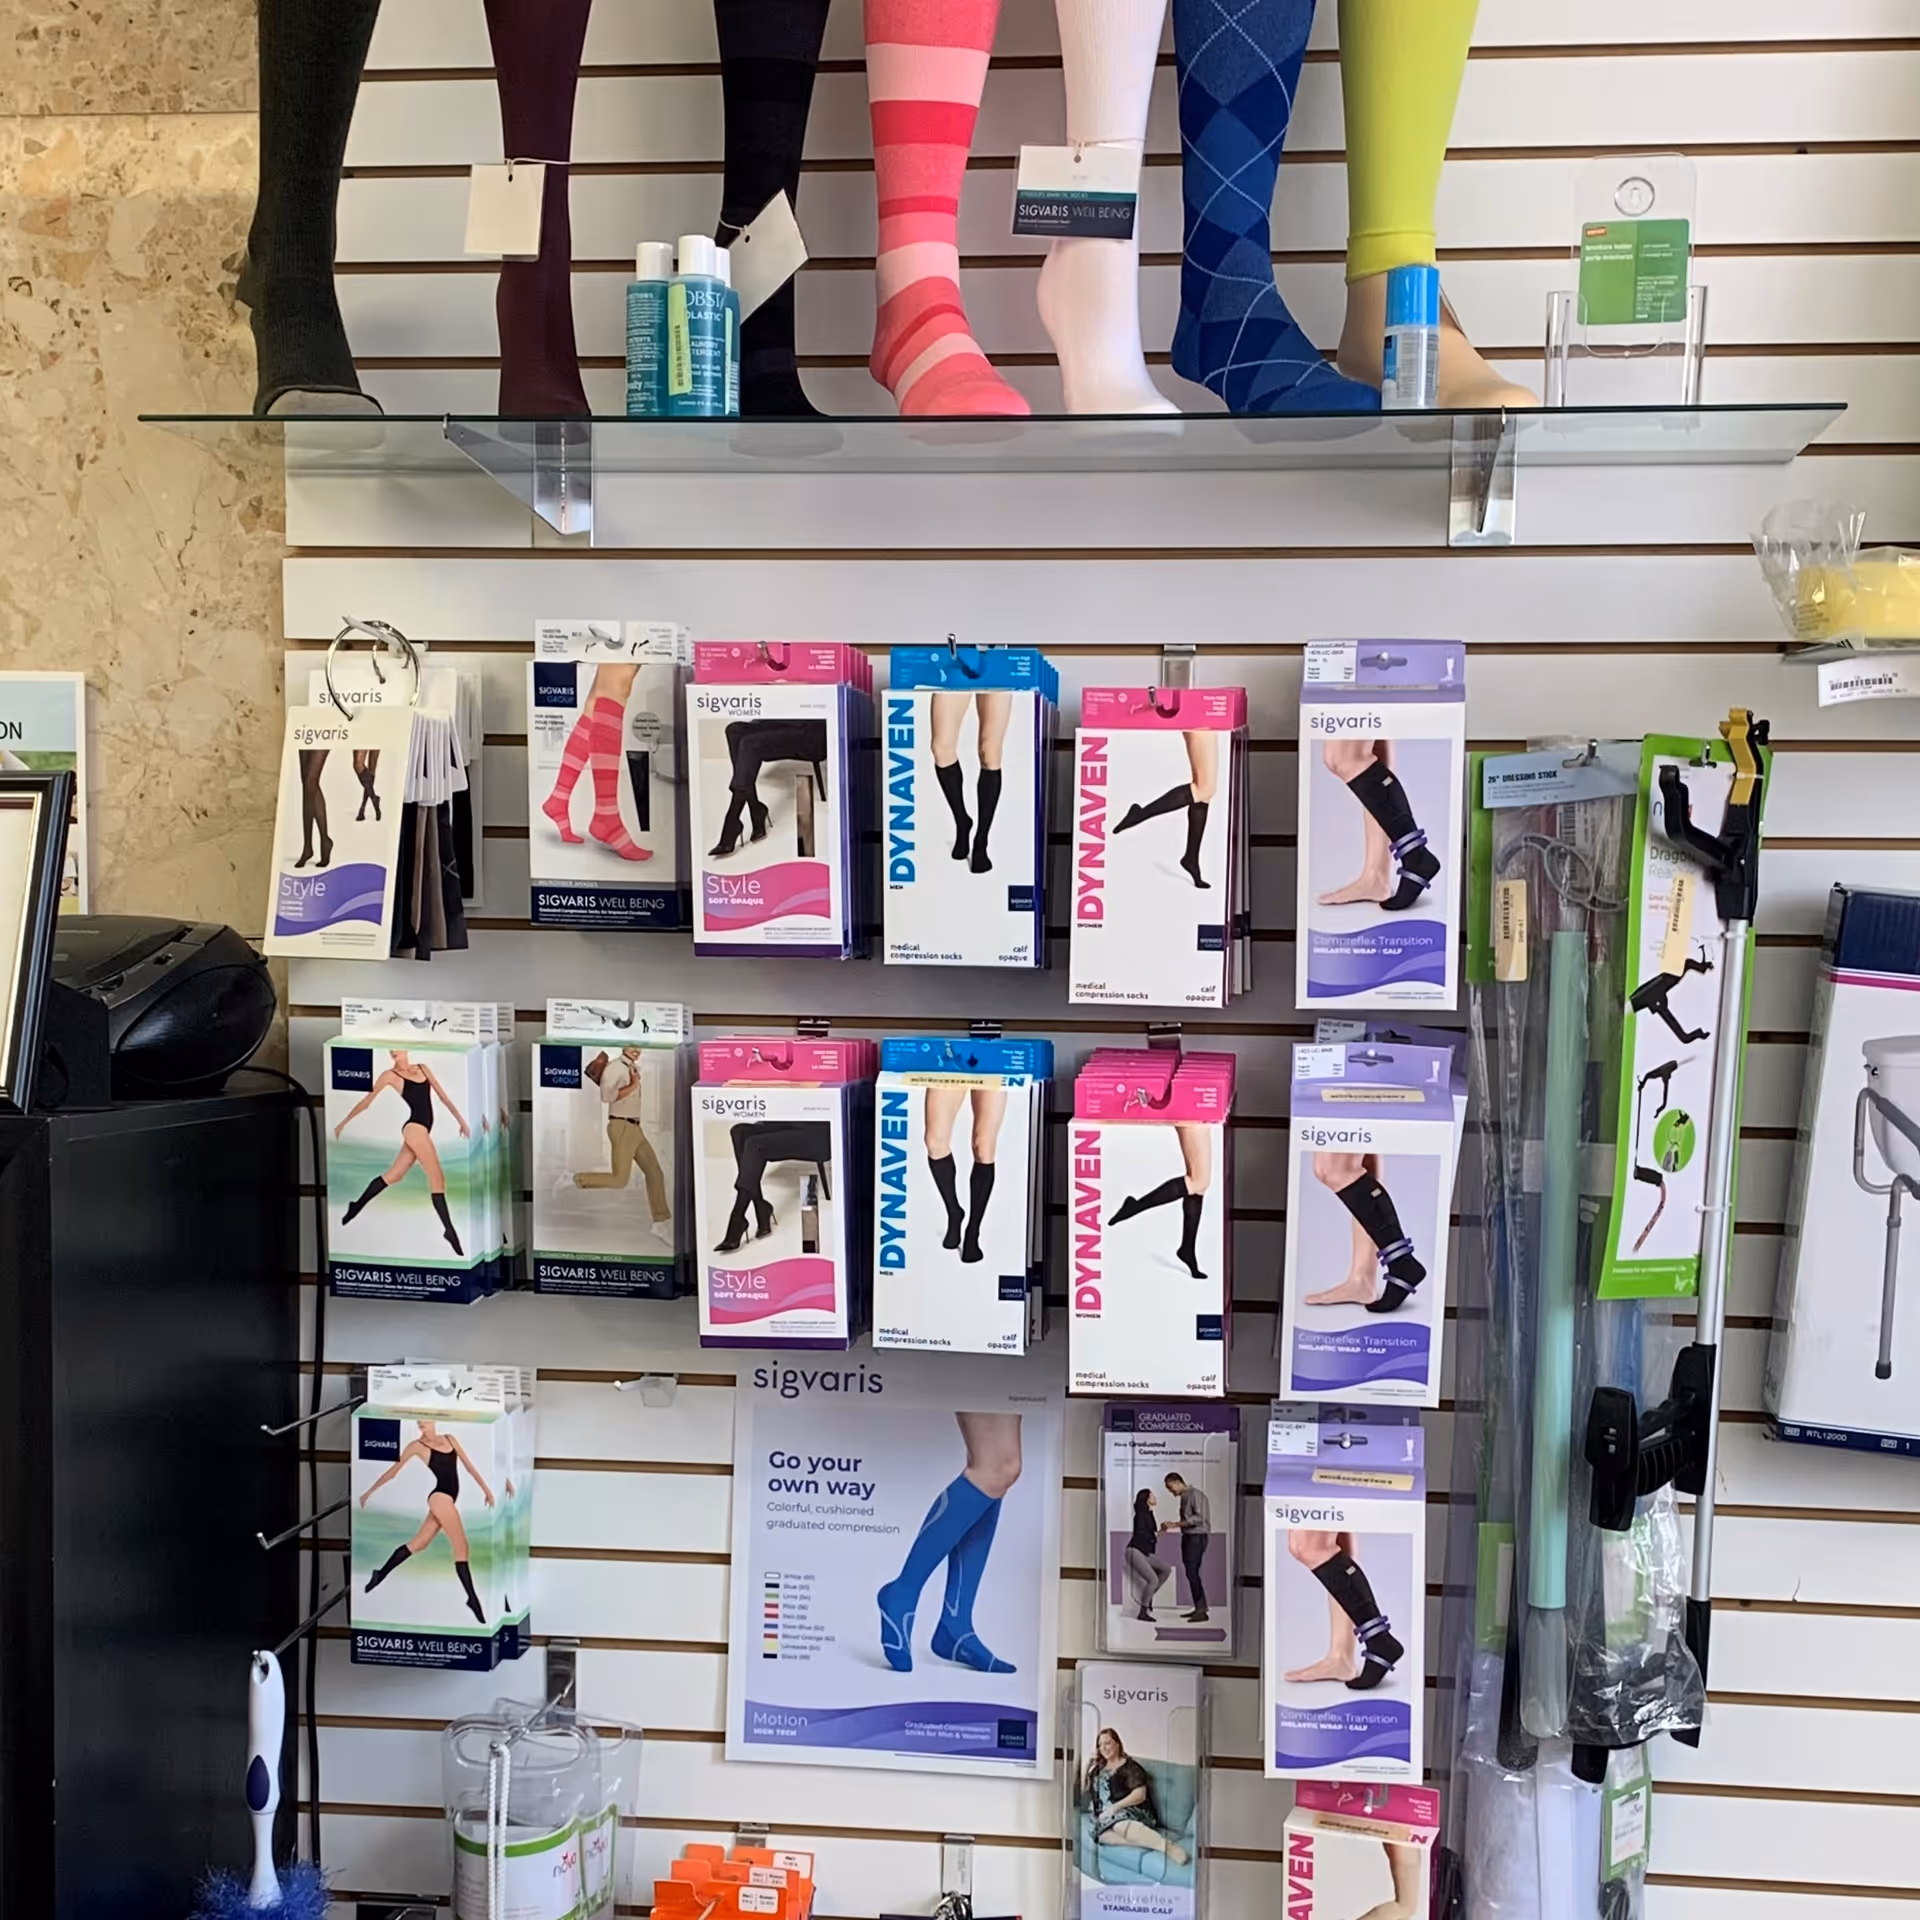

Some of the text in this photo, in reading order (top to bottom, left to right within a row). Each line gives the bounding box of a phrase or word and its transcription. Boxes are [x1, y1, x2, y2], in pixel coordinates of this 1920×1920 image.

[1019, 204, 1069, 217] SIGVARIS
[1098, 207, 1131, 219] BEING
[685, 290, 722, 308] OBST
[686, 311, 722, 321] OLASTIC
[696, 693, 762, 712] sigvaris
[1310, 712, 1382, 733] sigvaris
[294, 724, 349, 745] sigvaris
[1538, 770, 1557, 780] STICK
[888, 698, 916, 882] DYNAVEN
[1077, 737, 1108, 921] DYNAVEN
[281, 877, 326, 899] Style
[707, 875, 761, 897] Style
[538, 893, 665, 909] SIGVARIS WELL BEING
[890, 943, 920, 951] medical
[1313, 935, 1433, 947] Compreflex Transition
[890, 952, 963, 960] compression socks
[1012, 945, 1028, 953] calf
[998, 954, 1028, 962] opaque
[1075, 982, 1106, 990] medical
[1201, 985, 1216, 993] calf
[1075, 991, 1149, 1000] compression socks
[1185, 994, 1215, 1002] opaque
[337, 1069, 371, 1079] SIGVARIS
[544, 1067, 579, 1076] SIGVARIS
[702, 1095, 766, 1114] sigvaris
[1301, 1126, 1372, 1146] sigvaris
[879, 1091, 908, 1269] DYNAVEN
[1074, 1130, 1102, 1311] DYNAVEN
[335, 1268, 461, 1287] SIGVARIS WELL BEING
[539, 1265, 665, 1282] SIGVARIS WELL BEING
[712, 1270, 766, 1291] Style
[735, 1292, 769, 1300] OPAQUE
[879, 1327, 909, 1335] medical
[1002, 1333, 1017, 1341] calf
[879, 1336, 951, 1346] compression socks
[987, 1342, 1017, 1350] opaque
[1298, 1333, 1417, 1347] Compreflex Transition
[753, 1360, 883, 1399] sigvaris
[1075, 1380, 1149, 1389] compression socks
[1201, 1374, 1216, 1382] calf
[1186, 1383, 1216, 1391] opaque
[1138, 1413, 1191, 1421] GRADUATED
[1138, 1422, 1204, 1431] COMPRESSION
[768, 1450, 862, 1474] Go your
[768, 1477, 875, 1500] own way
[767, 1501, 874, 1517] Colorful, cushioned
[1275, 1504, 1344, 1523] sigvaris
[766, 1517, 900, 1536] graduated compression
[356, 1635, 482, 1654] SIGVARIS WELL BEING
[1103, 1684, 1168, 1704] sigvaris
[753, 1711, 808, 1727] Motion
[1280, 1710, 1398, 1724] Compreflex Transition
[905, 1721, 991, 1733] Graduated Compression
[938, 1731, 954, 1739] Men
[1288, 1833, 1314, 1920] AVEN
[1102, 1904, 1173, 1915] STANDARD CALF
